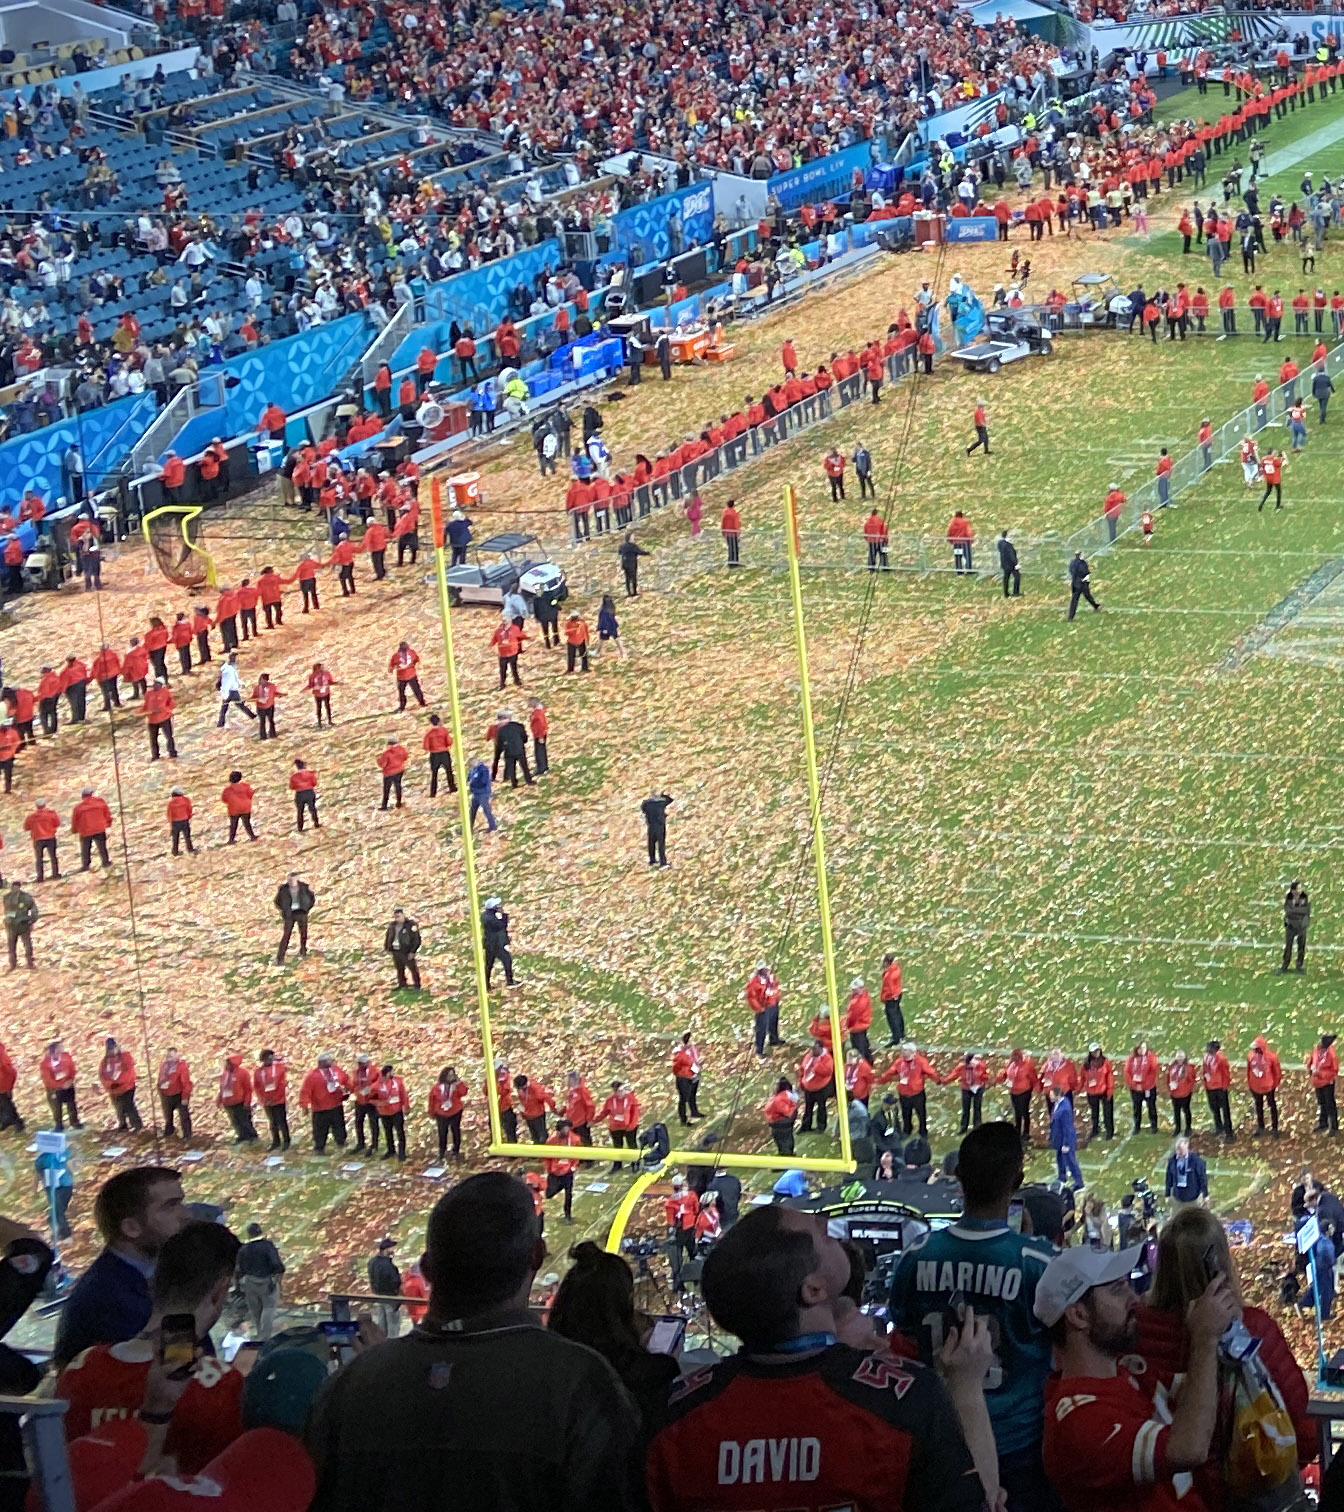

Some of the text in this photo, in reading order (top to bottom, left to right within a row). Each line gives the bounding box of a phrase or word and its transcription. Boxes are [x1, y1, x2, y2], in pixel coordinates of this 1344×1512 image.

[771, 159, 845, 196] SUPER BOWL LIV
[916, 1259, 1023, 1302] MARINO
[717, 1436, 821, 1485] DAVID
